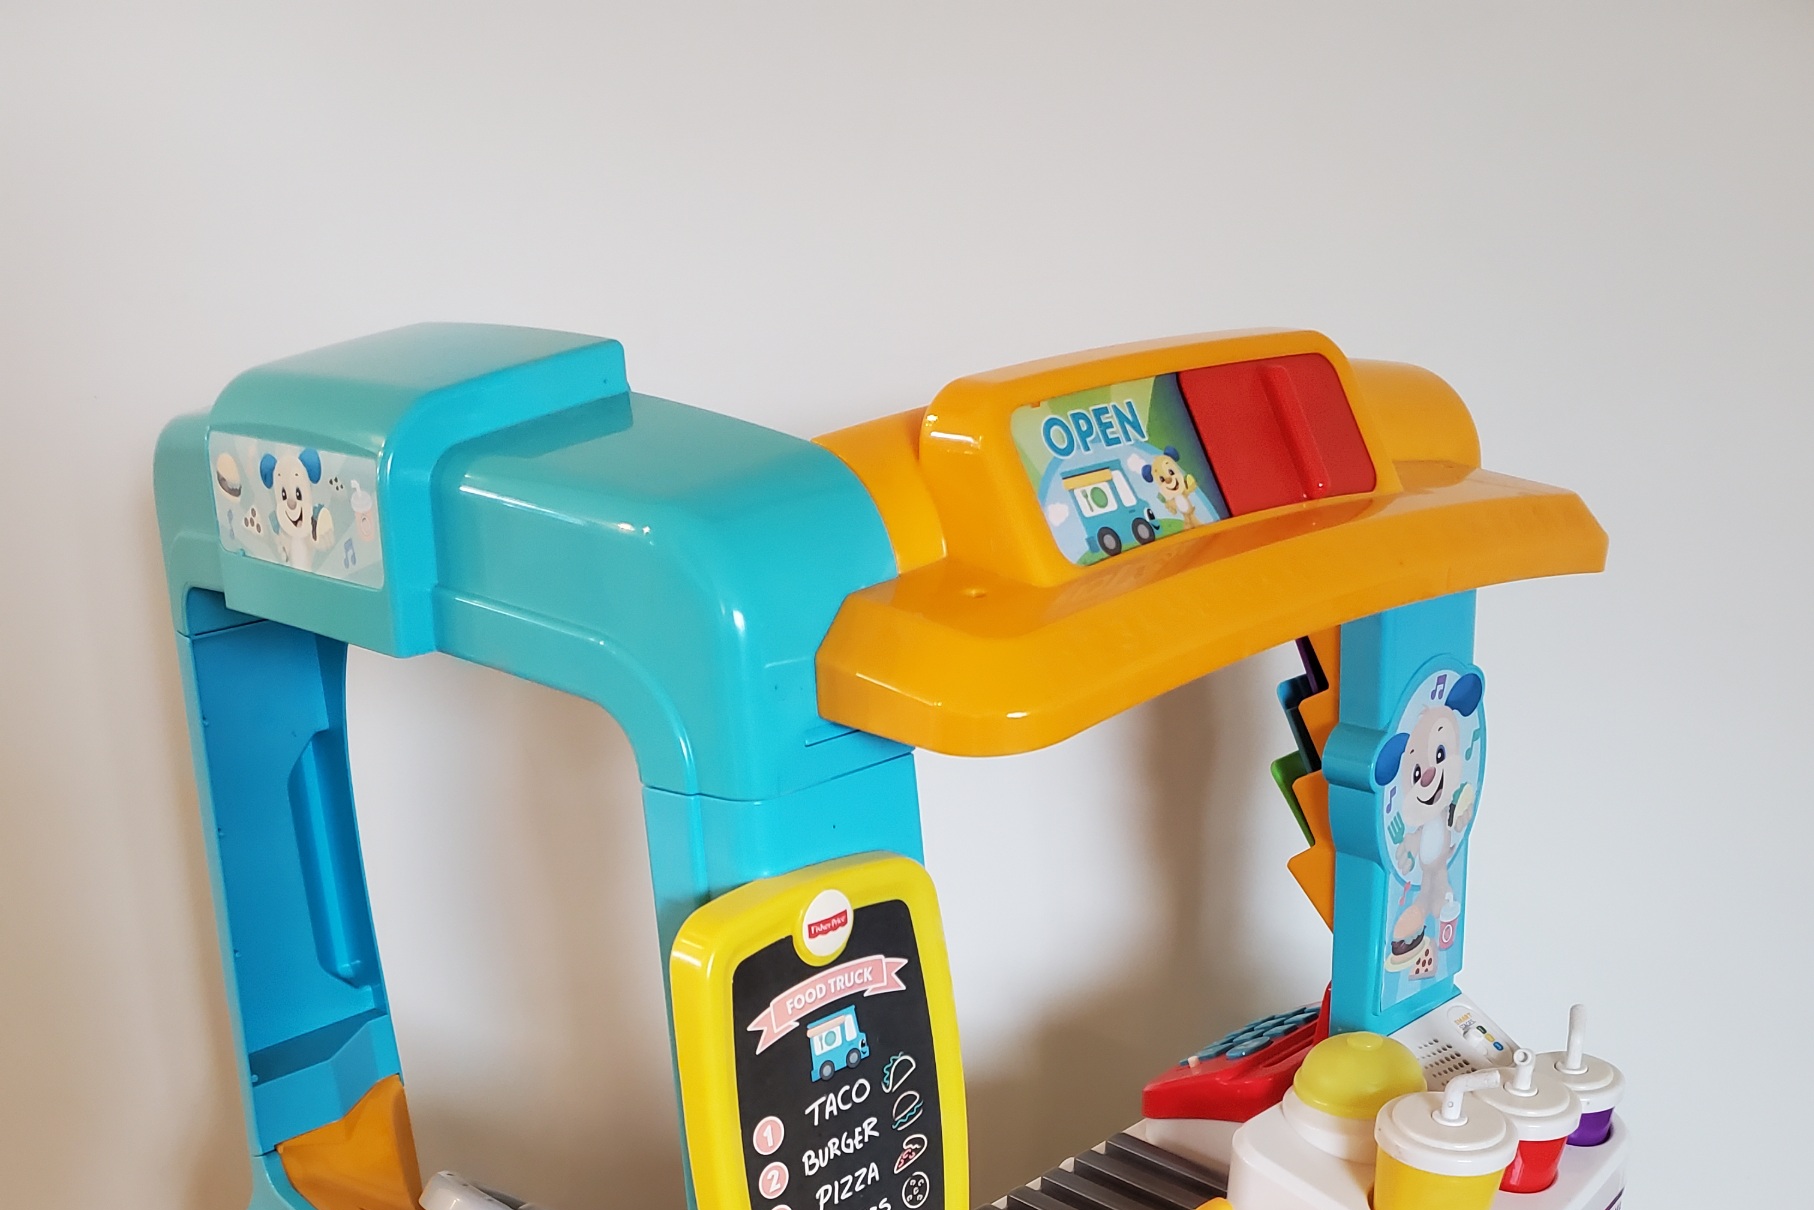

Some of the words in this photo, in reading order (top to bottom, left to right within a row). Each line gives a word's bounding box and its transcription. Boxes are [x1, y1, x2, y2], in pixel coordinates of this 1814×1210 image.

[1042, 399, 1147, 459] OPEN
[786, 983, 826, 1015] FOOD
[828, 966, 873, 993] TRUCK
[804, 1078, 871, 1127] TACO
[763, 1124, 775, 1147] 1
[802, 1116, 880, 1177] BURGER
[766, 1169, 782, 1193] 2
